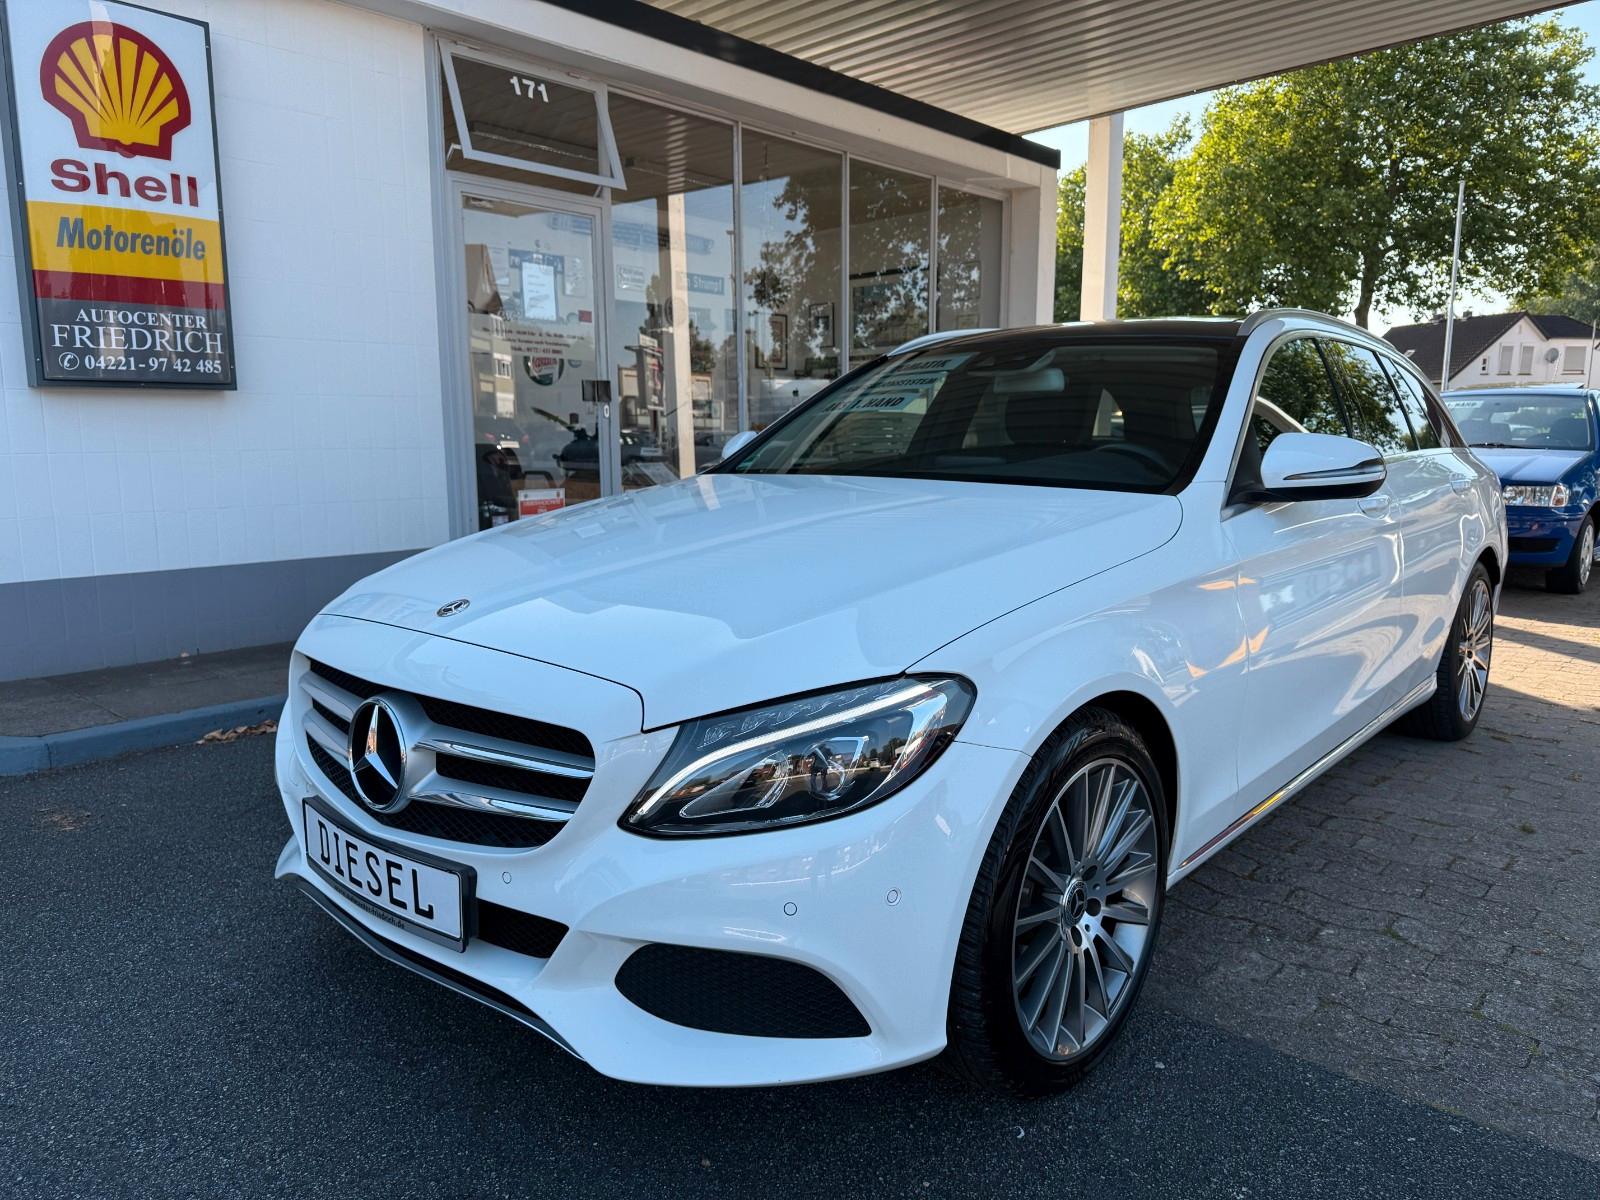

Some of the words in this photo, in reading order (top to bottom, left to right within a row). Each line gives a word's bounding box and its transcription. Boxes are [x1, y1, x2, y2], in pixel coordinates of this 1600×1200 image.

[510, 76, 549, 103] 171
[50, 158, 199, 208] Shell
[56, 216, 206, 261] Motorenöle
[76, 308, 207, 329] AUTOCENTER
[51, 324, 224, 354] FRIEDRICH
[173, 359, 191, 372] 42
[196, 359, 222, 374] 485
[318, 819, 434, 920] DIESEL
